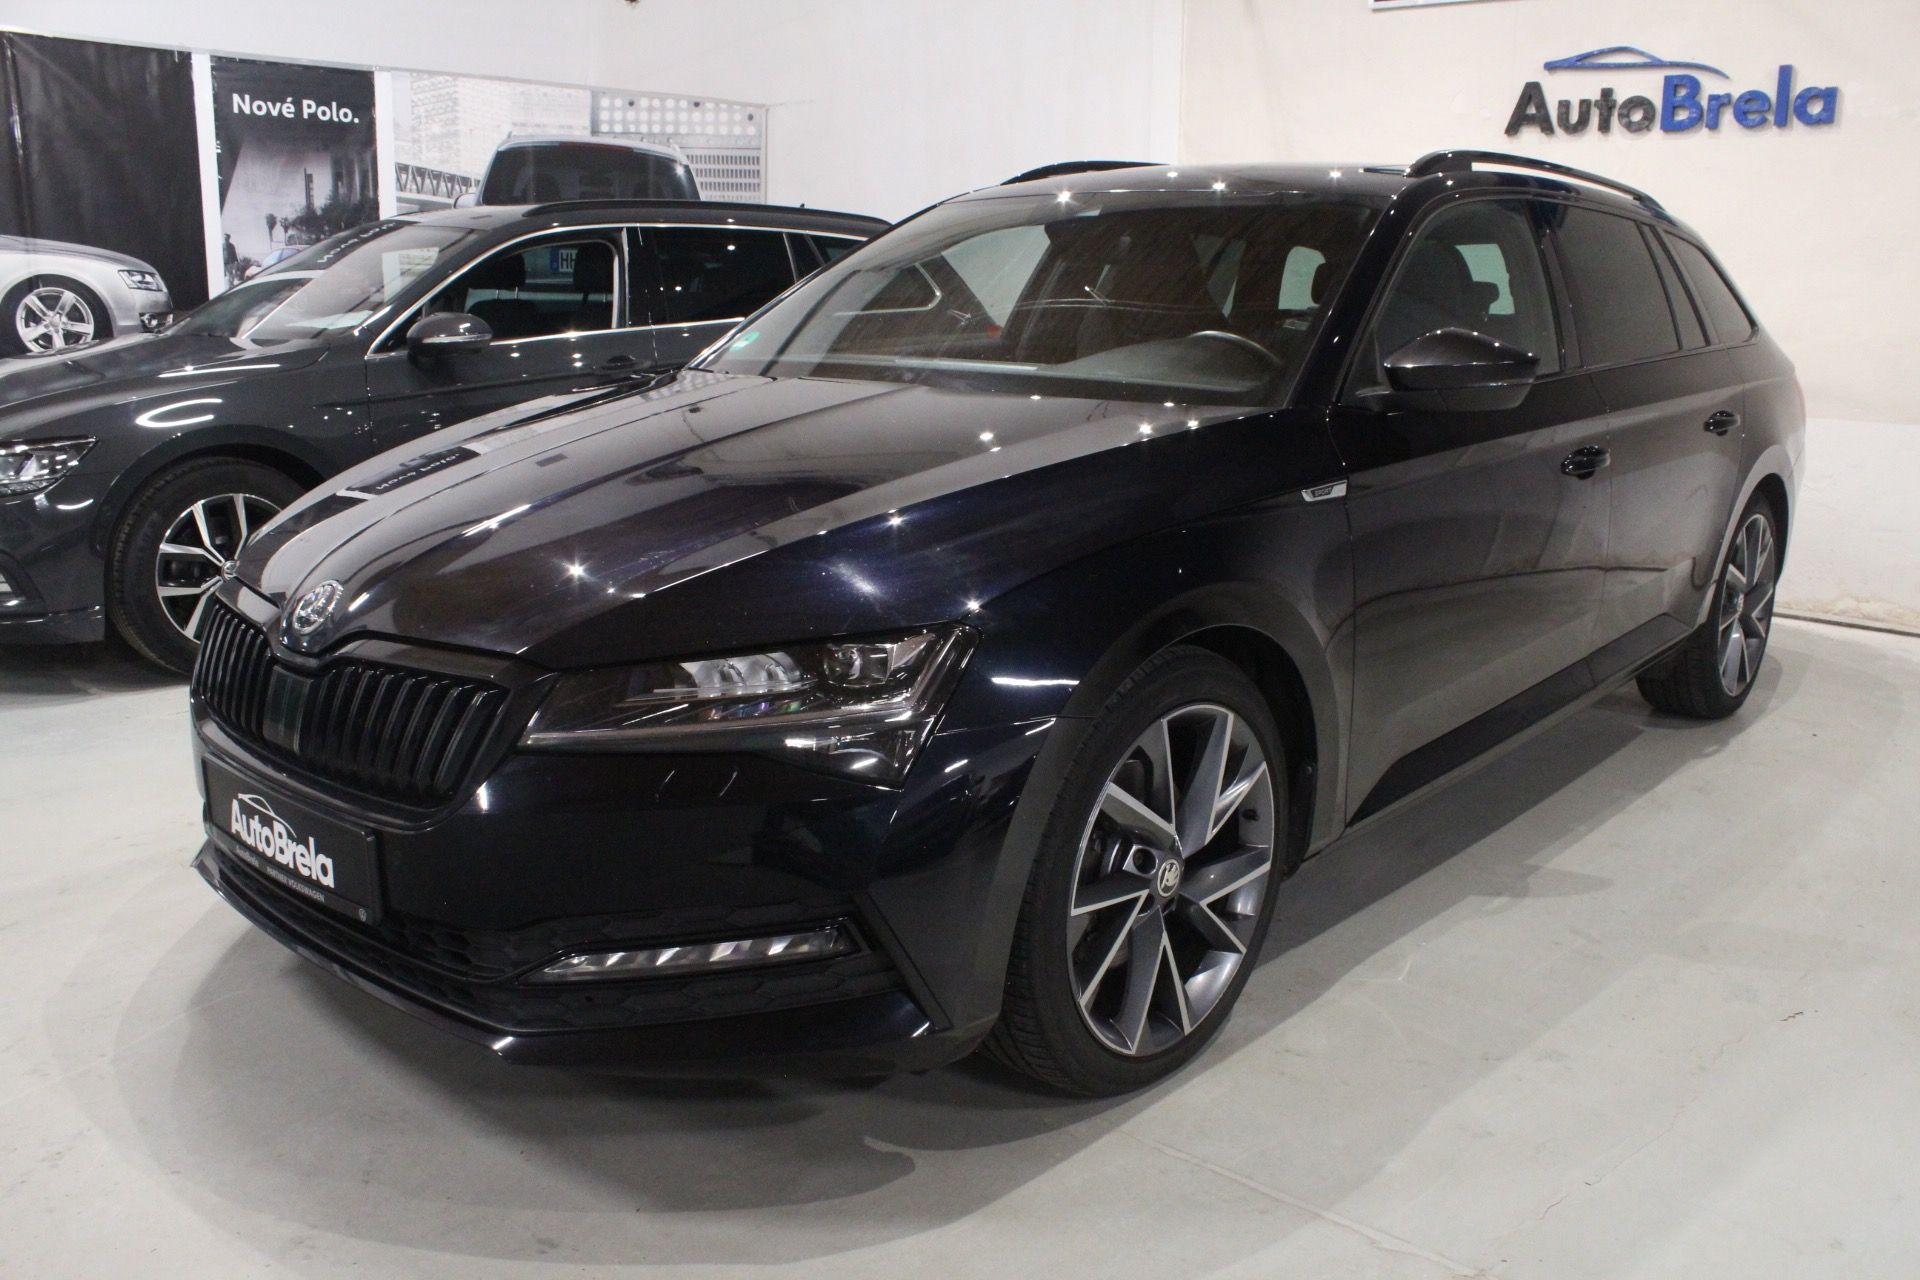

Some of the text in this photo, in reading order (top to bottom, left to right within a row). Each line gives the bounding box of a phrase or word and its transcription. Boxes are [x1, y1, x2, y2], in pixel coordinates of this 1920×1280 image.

[232, 93, 359, 123] Nové Polo.
[1504, 65, 1838, 136] AutoBrela
[231, 798, 335, 889] AutoBrela
